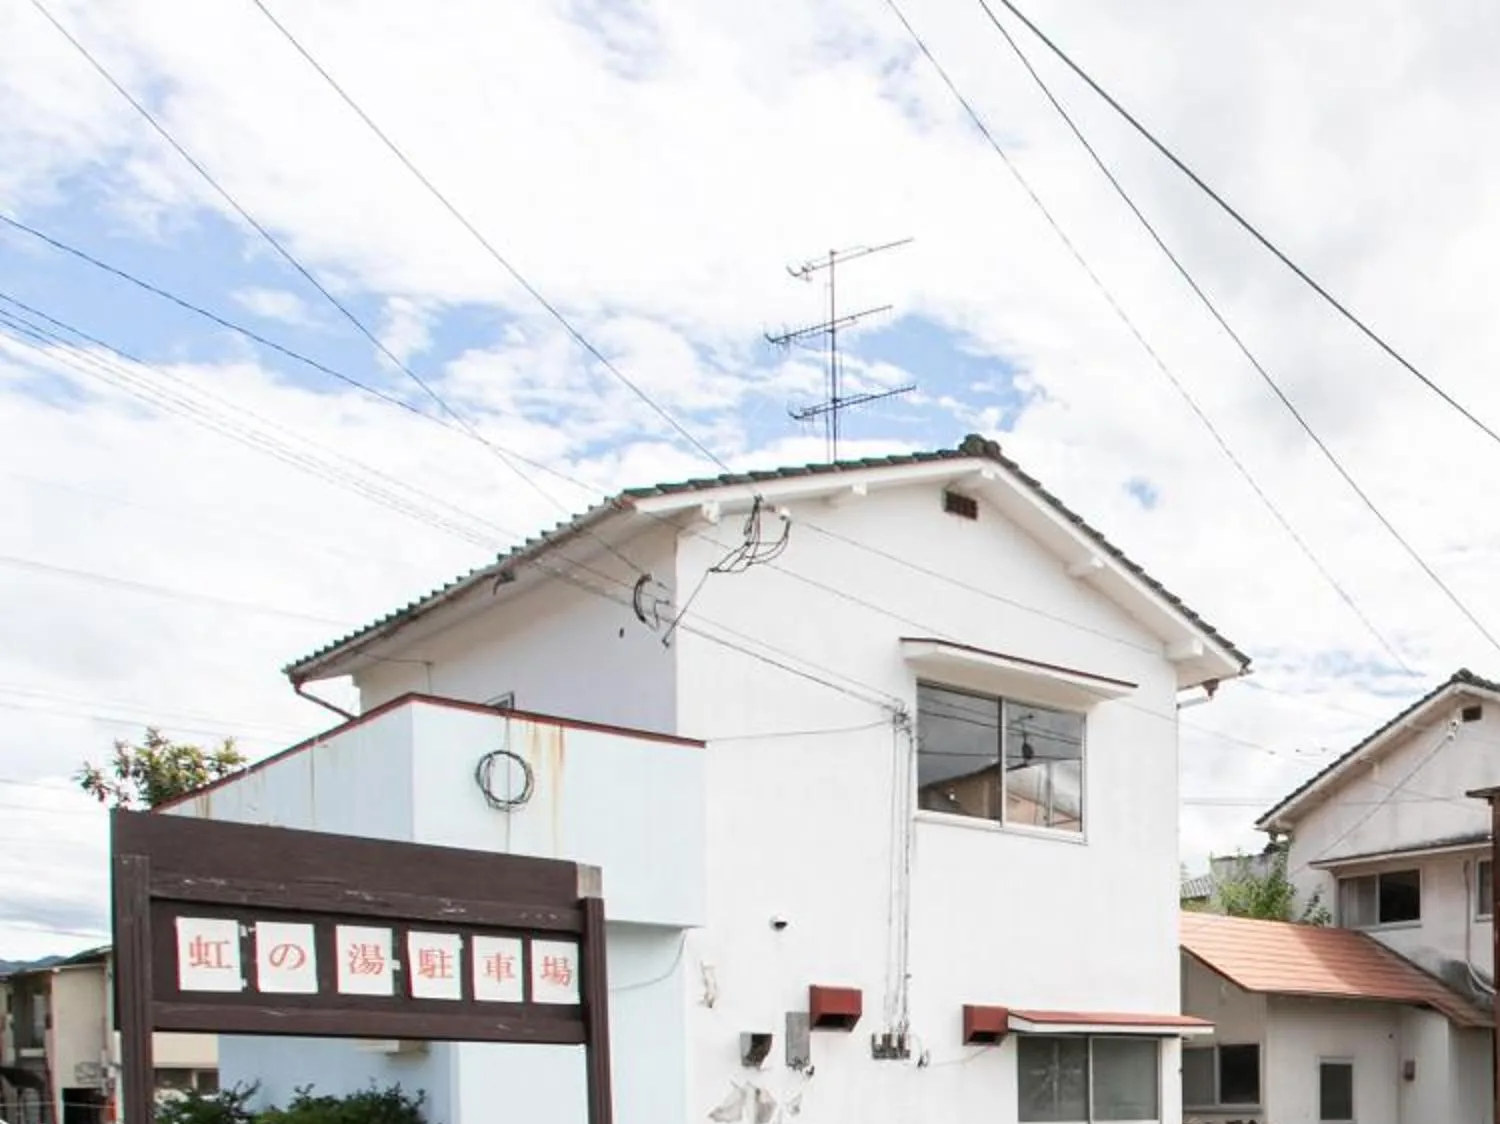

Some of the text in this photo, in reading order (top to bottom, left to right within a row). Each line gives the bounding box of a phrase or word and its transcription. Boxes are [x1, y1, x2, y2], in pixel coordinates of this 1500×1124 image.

[189, 934, 573, 986] 虹の湯駐車場
